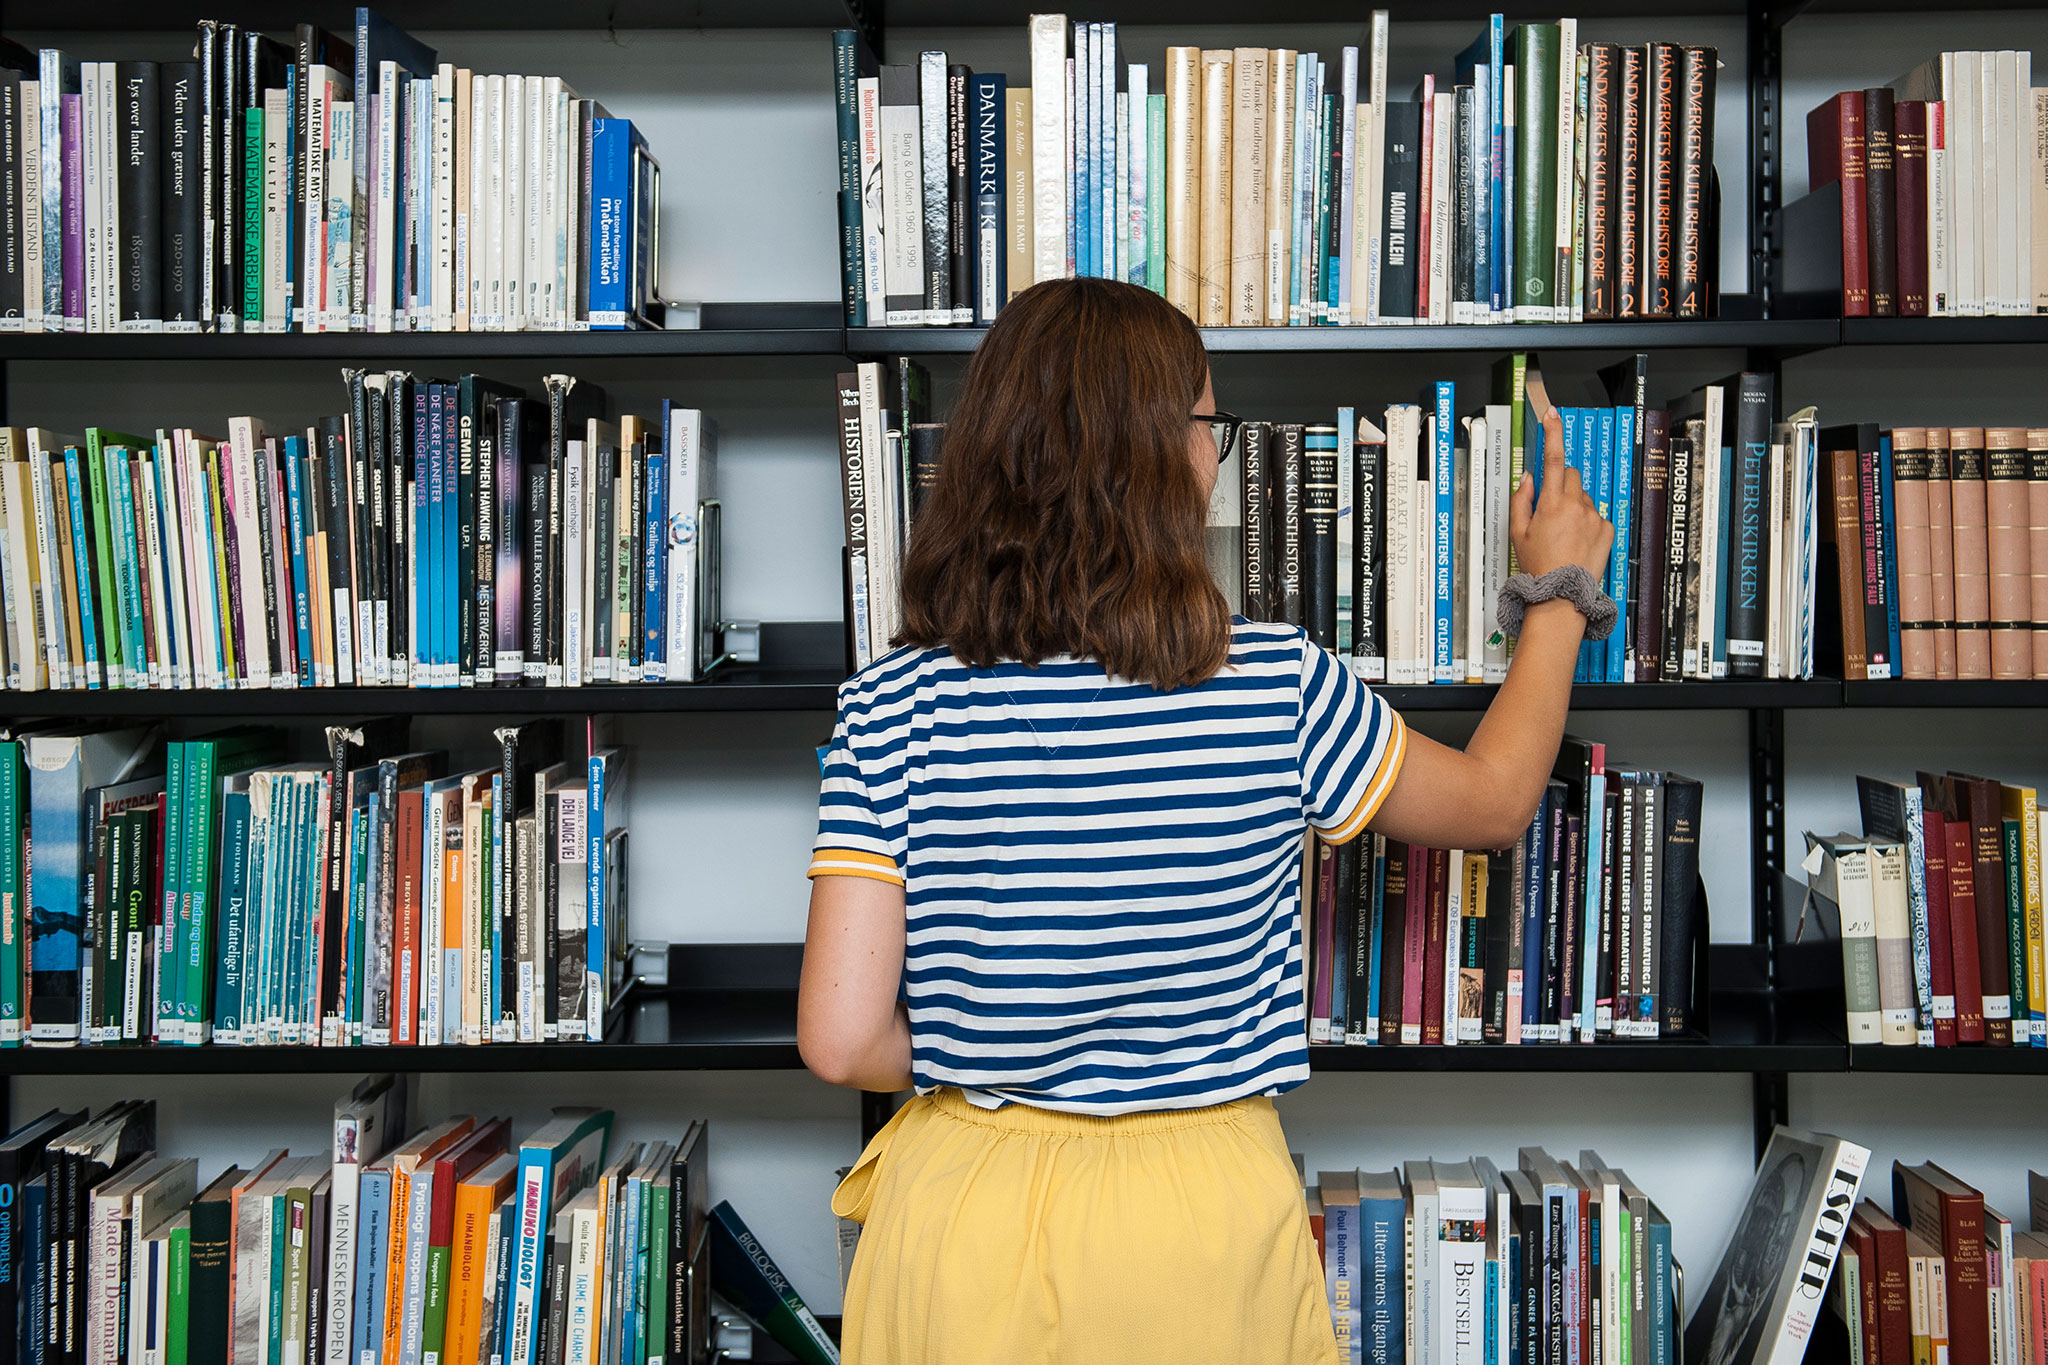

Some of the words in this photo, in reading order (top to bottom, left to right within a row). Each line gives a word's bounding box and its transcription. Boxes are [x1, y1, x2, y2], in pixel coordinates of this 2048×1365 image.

[4, 87, 12, 115] BJØRN
[129, 78, 142, 98] Lys
[175, 80, 187, 115] Viden
[1594, 47, 1610, 156] HÅNDVÆRKETS
[1624, 52, 1641, 161] HÅNDVÆRKETS
[1658, 47, 1675, 156] HÅNDVÆRKETS
[1689, 51, 1706, 159] HÅNDVÆRKETS
[131, 102, 140, 127] over
[864, 89, 874, 127] Robotterne
[131, 130, 143, 166] landet
[175, 118, 186, 147] uden
[865, 130, 875, 154] iblandt
[980, 83, 995, 193] DANMARK
[172, 151, 184, 196] grænser
[268, 142, 276, 214] KULTUR
[866, 156, 875, 164] os
[246, 136, 259, 239] MATEMATISKE
[1016, 171, 1025, 215] KVINDER
[6, 208, 14, 234] SANDE
[1390, 192, 1406, 229] NAOMI
[1592, 161, 1607, 280] KULTURHISTORIE
[1621, 167, 1636, 286] KULTURHISTORIE
[1657, 160, 1670, 279] KULTURHISTORIE
[1684, 165, 1699, 283] KULTURHISTORIE
[7, 237, 15, 273] TILSTAND
[601, 198, 612, 284] matematikken
[612, 234, 622, 270] fortælling
[1016, 225, 1025, 253] KAMP
[1389, 233, 1405, 265] KLEIN
[131, 235, 141, 291] 1850-1920
[174, 233, 182, 291] 1920-1970
[354, 252, 362, 277] Allan
[613, 272, 619, 283] om
[871, 266, 878, 276] Ro
[245, 244, 258, 321] ARBEJDER
[353, 280, 362, 313] Baktoft
[871, 279, 879, 294] Udl.
[1595, 289, 1603, 312] 1
[1658, 288, 1669, 312] 3
[1620, 294, 1634, 316] 2
[1683, 291, 1697, 315] 4
[416, 395, 425, 414] DET
[431, 395, 440, 409] DE
[446, 398, 455, 411] DE
[416, 417, 426, 459] SYNLIGE
[431, 413, 440, 446] NÆRE
[446, 415, 455, 440] YDRE
[460, 416, 472, 474] GEMINI
[446, 443, 456, 493] PLANETER
[480, 440, 490, 488] STEPHEN
[844, 418, 864, 509] HISTORIEN
[1247, 430, 1259, 477] DANSK
[1286, 432, 1297, 480] DANSK
[1862, 453, 1873, 473] TYSK
[417, 462, 426, 507] UNIVERS
[431, 450, 441, 502] PLANETER
[569, 466, 579, 488] Fysik
[1364, 472, 1372, 481] A
[1673, 451, 1688, 502] TROENS
[479, 491, 491, 541] HAWKING
[569, 495, 579, 538] øjenhøjde
[1363, 483, 1373, 521] Concise
[1863, 476, 1874, 521] LITTERATUR
[534, 519, 543, 532] EN
[852, 513, 865, 541] OM
[1248, 483, 1260, 595] KUNSTHISTORIE
[1285, 484, 1299, 595] KUNSTHISTORIE
[1362, 524, 1373, 563] History
[1438, 512, 1449, 565] SPORTENS
[1670, 504, 1685, 564] BILLEDER
[1740, 440, 1766, 610] PETERSKIRKEN
[1864, 524, 1875, 546] EFTER
[534, 534, 542, 560] LILLE
[1865, 549, 1876, 583] MURENS
[534, 562, 542, 581] BOG
[1364, 565, 1373, 576] of
[1438, 568, 1449, 600] KUNST
[534, 583, 542, 601] OM
[1363, 579, 1373, 616] Russian
[1867, 585, 1877, 604] FALD
[479, 585, 490, 666] MESTERVÆRKET
[533, 603, 542, 655] UNIVERSET
[1363, 618, 1373, 637] Art
[562, 799, 574, 815] DEN
[1646, 789, 1654, 803] DE
[519, 829, 528, 867] AFRICAN
[562, 818, 574, 840] LANGE
[1645, 806, 1654, 852] LEVENDE
[2009, 830, 2017, 862] THOMAS
[132, 842, 141, 885] JØRGENSEN
[562, 843, 574, 859] VEJ
[592, 837, 600, 873] Levende
[1360, 834, 1368, 869] ISLAMISK
[519, 869, 528, 912] POLITICAL
[591, 877, 600, 926] organismer
[1359, 872, 1368, 900] KUNST
[1470, 863, 1478, 915] TEATRETS
[1643, 855, 1653, 912] BILLEDERS
[2011, 866, 2019, 913] BREDSDORFF
[129, 890, 142, 928] Grønt
[230, 898, 242, 916] Det
[1358, 909, 1366, 937] DAVIDS
[226, 920, 241, 972] ufattelige
[519, 914, 528, 954] SYSTEMS
[1642, 915, 1652, 984] DRAMATURGI
[2013, 942, 2020, 954] OG
[1356, 939, 1365, 976] SAMLING
[226, 973, 238, 986] liv
[2014, 957, 2022, 1001] KÆRLIGHED
[106, 1207, 121, 1256] Made
[520, 1181, 539, 1289] IMMUNOBIOLOGY
[1635, 1217, 1643, 1231] Det
[1797, 1169, 1858, 1300] ESCHER
[0, 1212, 10, 1282] OPFINDELSER
[462, 1214, 475, 1281] HUMANBIOLOGI
[738, 1232, 789, 1293] BIOLOGISK
[1374, 1221, 1389, 1305] Litteraturens
[1635, 1233, 1643, 1269] litterære
[105, 1264, 119, 1280] in
[331, 1205, 349, 1360] MENNESKEKROPPEN
[575, 1274, 588, 1302] TARME
[675, 1262, 684, 1277] Vor
[675, 1279, 683, 1323] fantastiske
[1635, 1270, 1643, 1310] væksthus
[104, 1285, 120, 1365] Denmark
[574, 1307, 586, 1324] MED
[572, 1327, 585, 1363] CHARME
[673, 1326, 683, 1353] hjerne
[1372, 1310, 1389, 1364] tilgange
